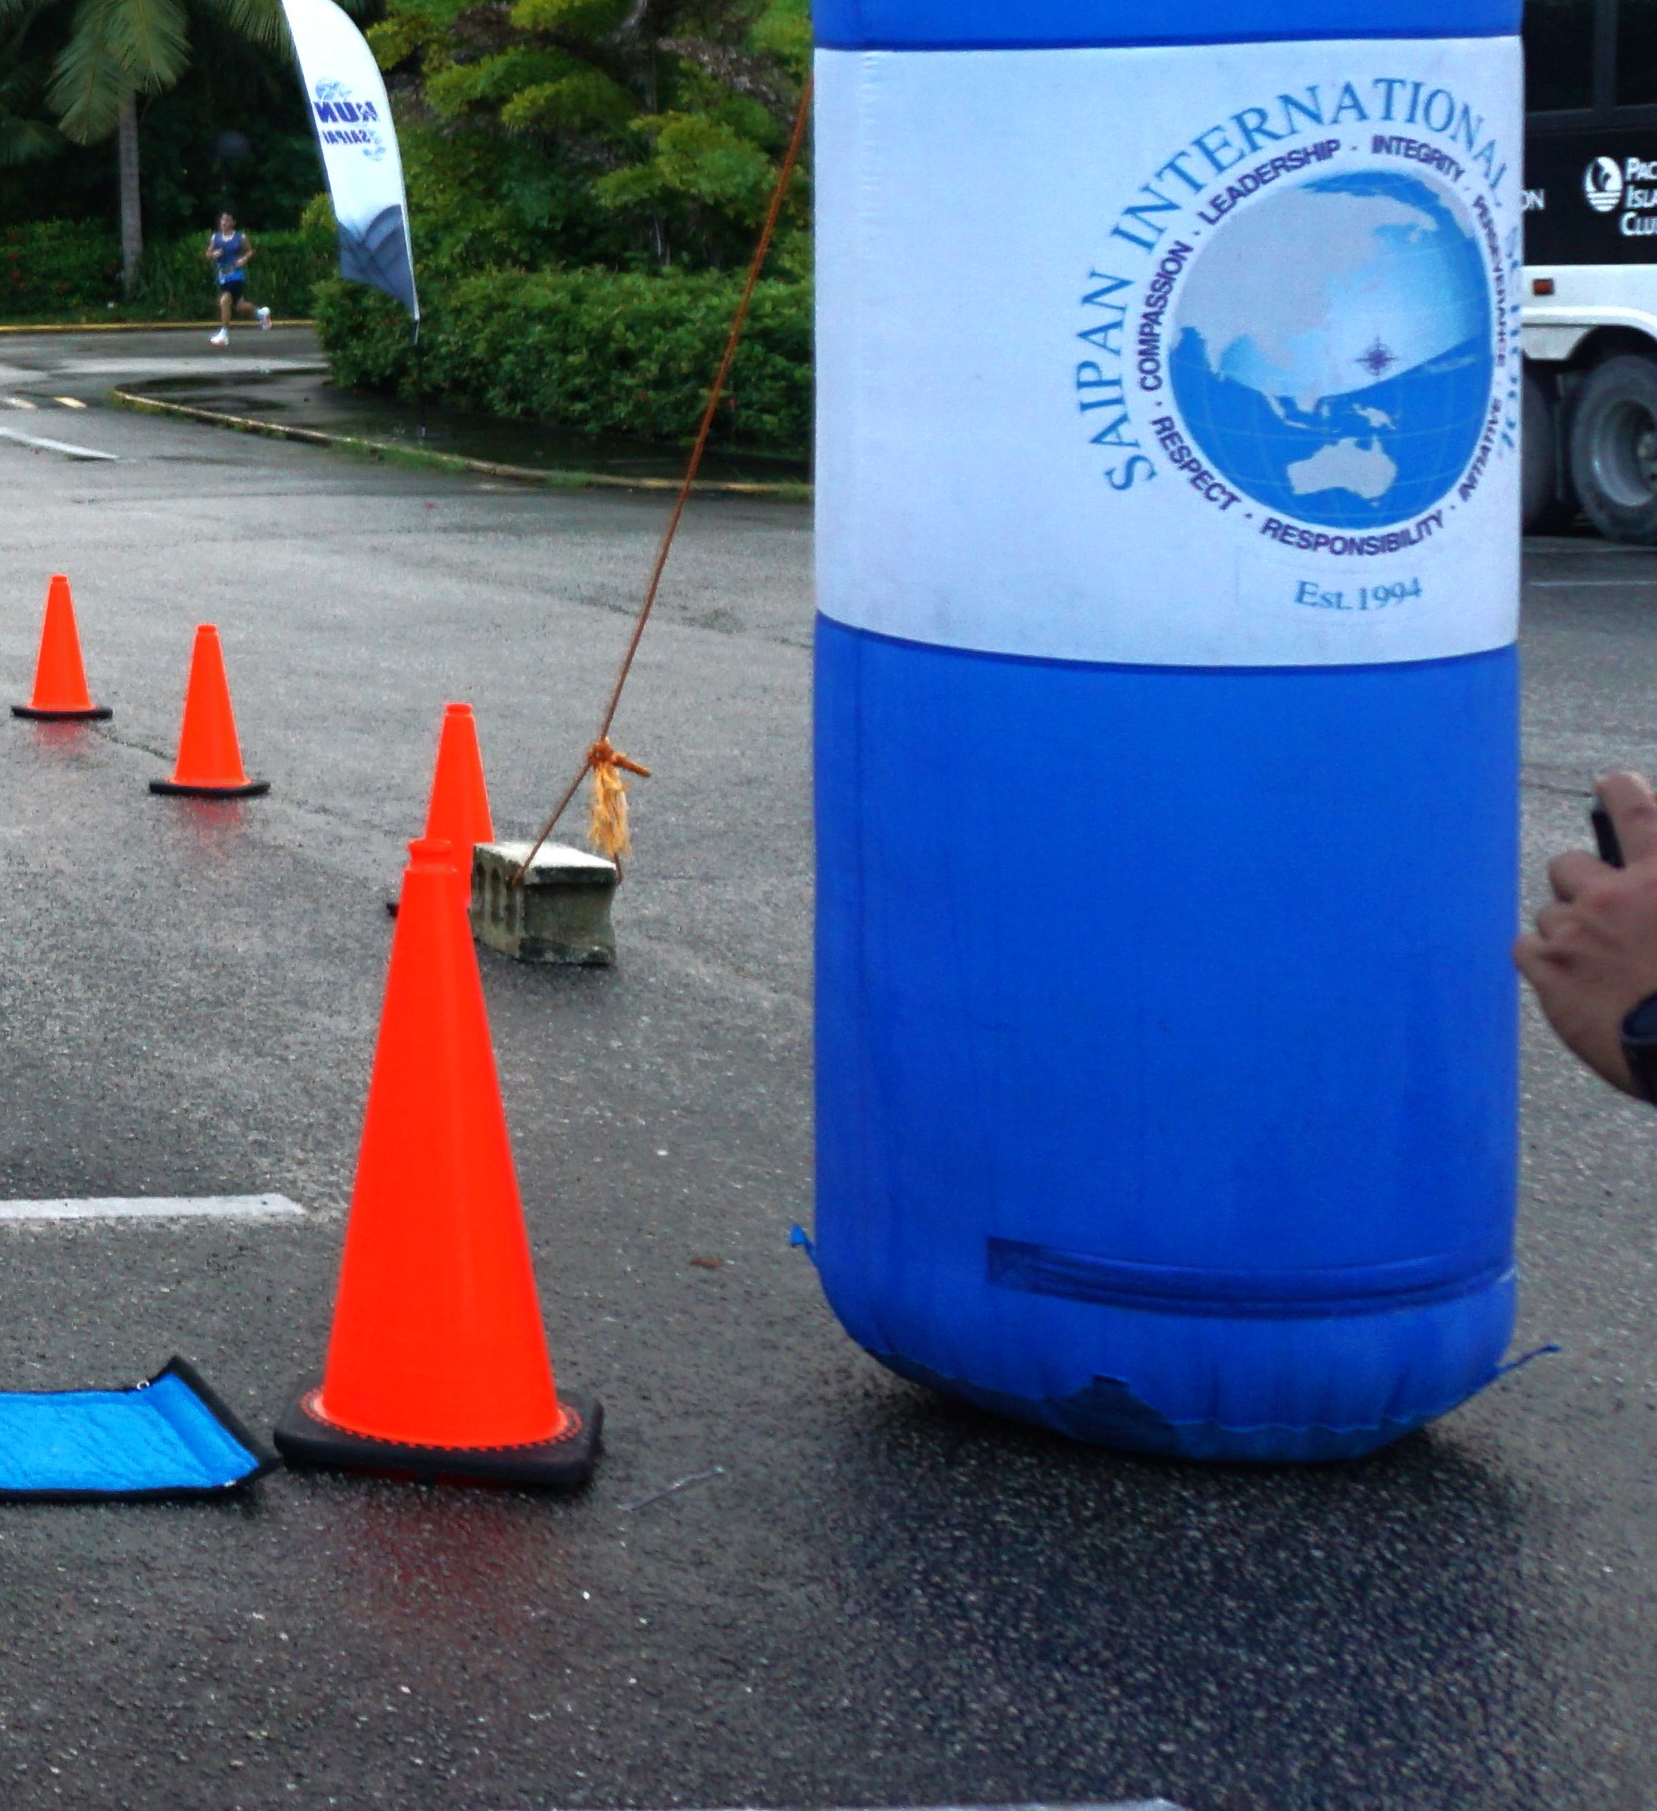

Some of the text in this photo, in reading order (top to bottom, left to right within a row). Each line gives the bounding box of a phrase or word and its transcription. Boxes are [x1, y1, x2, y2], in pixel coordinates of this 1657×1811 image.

[1197, 138, 1342, 225] LEADERSHIP
[1371, 134, 1466, 183] INTEGRITY
[1138, 240, 1194, 392] COMPASSION
[1075, 270, 1158, 492] SAIPAN
[1150, 415, 1242, 512] RESPECT
[1260, 509, 1446, 557] RESPONSIBILITY
